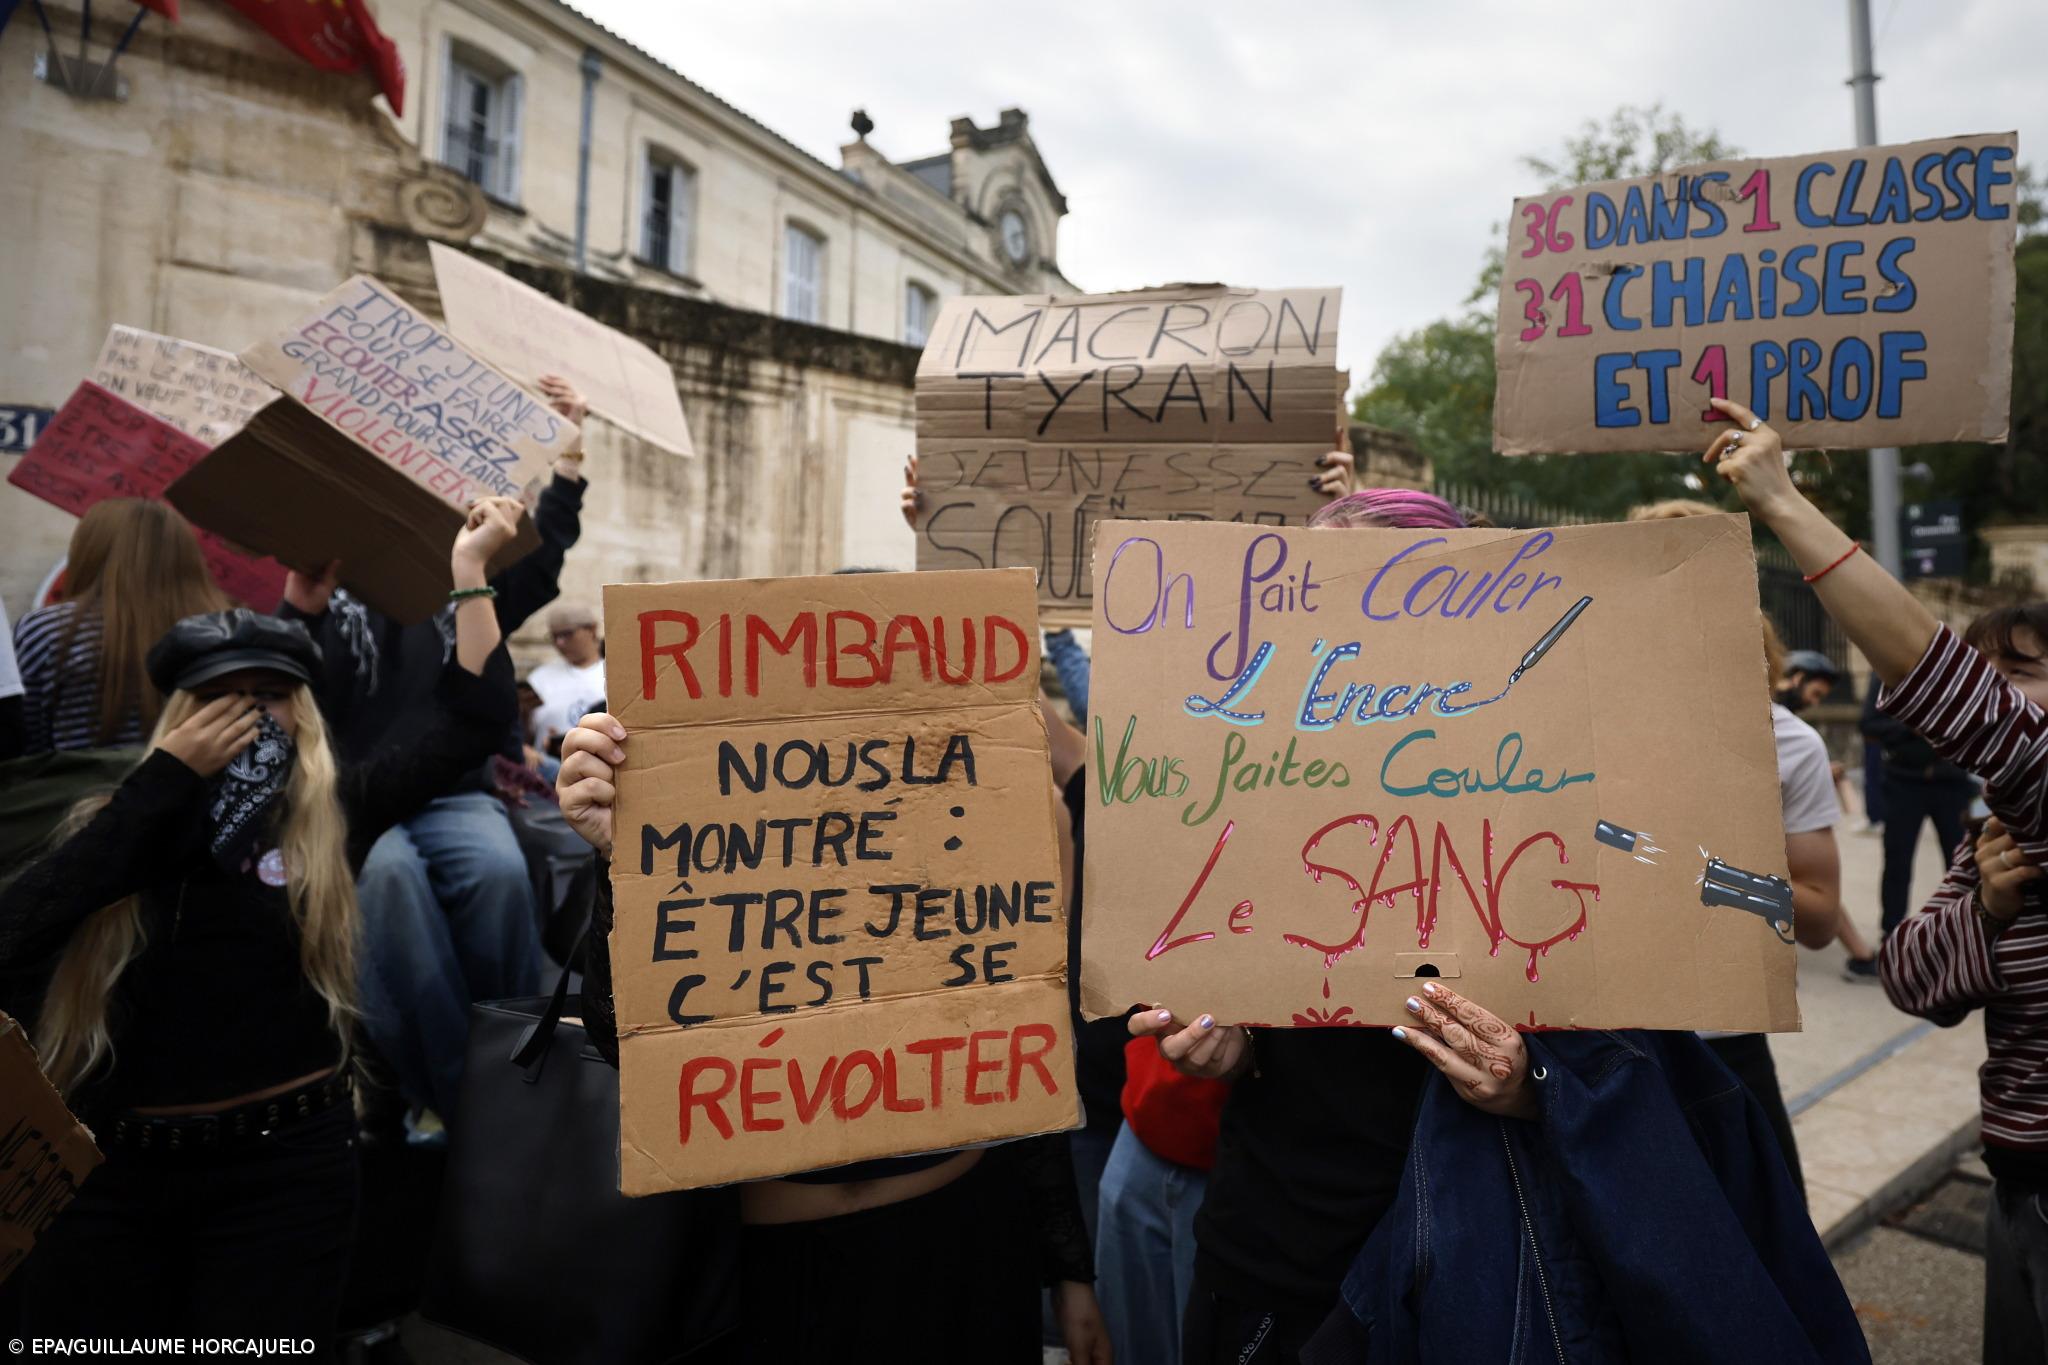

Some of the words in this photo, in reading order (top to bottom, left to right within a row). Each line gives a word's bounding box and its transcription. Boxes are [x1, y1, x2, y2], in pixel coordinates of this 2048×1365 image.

[1522, 196, 1575, 258] 36
[1585, 171, 1731, 249] DANS
[1741, 168, 1781, 232] 1
[1795, 146, 2013, 227] CLASSE
[952, 295, 1327, 369] MACRON
[1516, 271, 1593, 341] 31
[300, 319, 420, 407] ECOUTER
[413, 401, 520, 476] ASSEZ
[326, 304, 410, 371] POUR
[409, 364, 447, 395] SE
[451, 387, 519, 442] FAIRE
[354, 281, 454, 356] TROP
[445, 354, 561, 443] JEUNES
[957, 361, 1274, 436] TYRAN
[1594, 349, 1681, 428] ET
[1690, 344, 1731, 422] 1
[1750, 331, 1927, 421] PROF
[281, 340, 381, 409] GRAND
[380, 401, 437, 443] POUR
[436, 435, 460, 464] SE
[460, 455, 520, 498] FAIRE
[929, 447, 1303, 499] JEUNESSE
[1103, 536, 1196, 635] On
[1361, 531, 1562, 622] Couler
[637, 609, 1029, 700] RIMBAUD
[718, 739, 891, 796] NOUS
[900, 735, 977, 786] LA
[1094, 714, 1190, 807] Vous
[1380, 729, 1595, 798] Couler
[640, 796, 904, 878] MONTRÉ
[652, 881, 848, 962] ÊTRE
[864, 880, 1055, 942] JEUNE
[1145, 818, 1255, 960] Le
[1283, 814, 1600, 978] SANG
[667, 956, 884, 1028] C'EST
[941, 941, 1017, 987] SE
[678, 1023, 1060, 1147] RÉVOLTER
